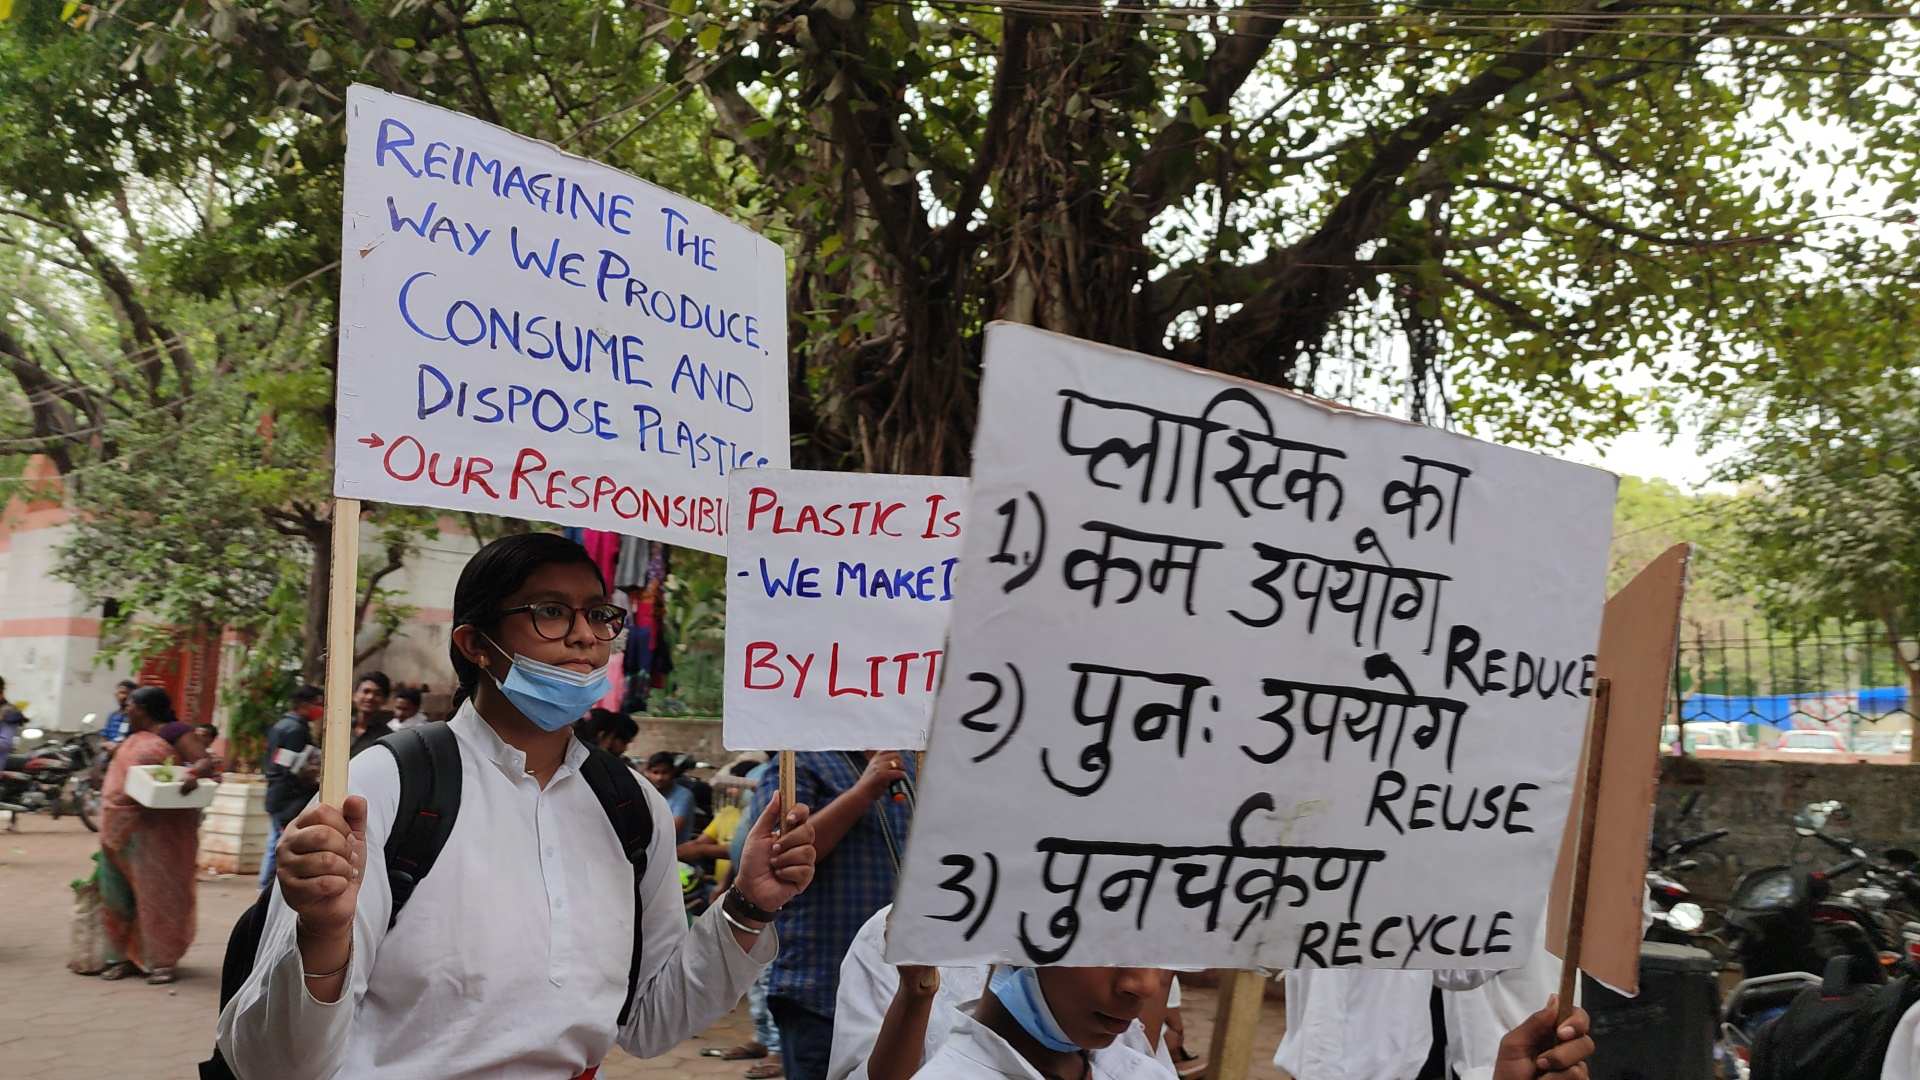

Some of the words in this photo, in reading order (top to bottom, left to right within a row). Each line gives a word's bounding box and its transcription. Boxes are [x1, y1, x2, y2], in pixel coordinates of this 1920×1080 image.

[375, 117, 634, 236] REIMAGINE
[661, 207, 717, 272] THE
[387, 196, 491, 256] WAY
[398, 271, 652, 388] CONSUME
[671, 354, 754, 413] AND
[417, 363, 619, 440] DISPOSE
[383, 435, 500, 500] OUR
[508, 447, 729, 537] RESPONSIBI
[1057, 387, 1347, 522] प्लास्टिक
[1381, 454, 1472, 544] का
[746, 485, 906, 538] PLASTIC
[759, 557, 822, 599] WE
[1063, 520, 1224, 616] कम
[1228, 527, 1454, 656] उपयोग
[1444, 624, 1597, 700] REDUCE
[960, 662, 1025, 762] 2)
[1240, 654, 1469, 773] उपयोग
[1365, 769, 1541, 835] REUSE
[924, 851, 999, 941] 3)
[1294, 911, 1513, 969] RECYCLE
